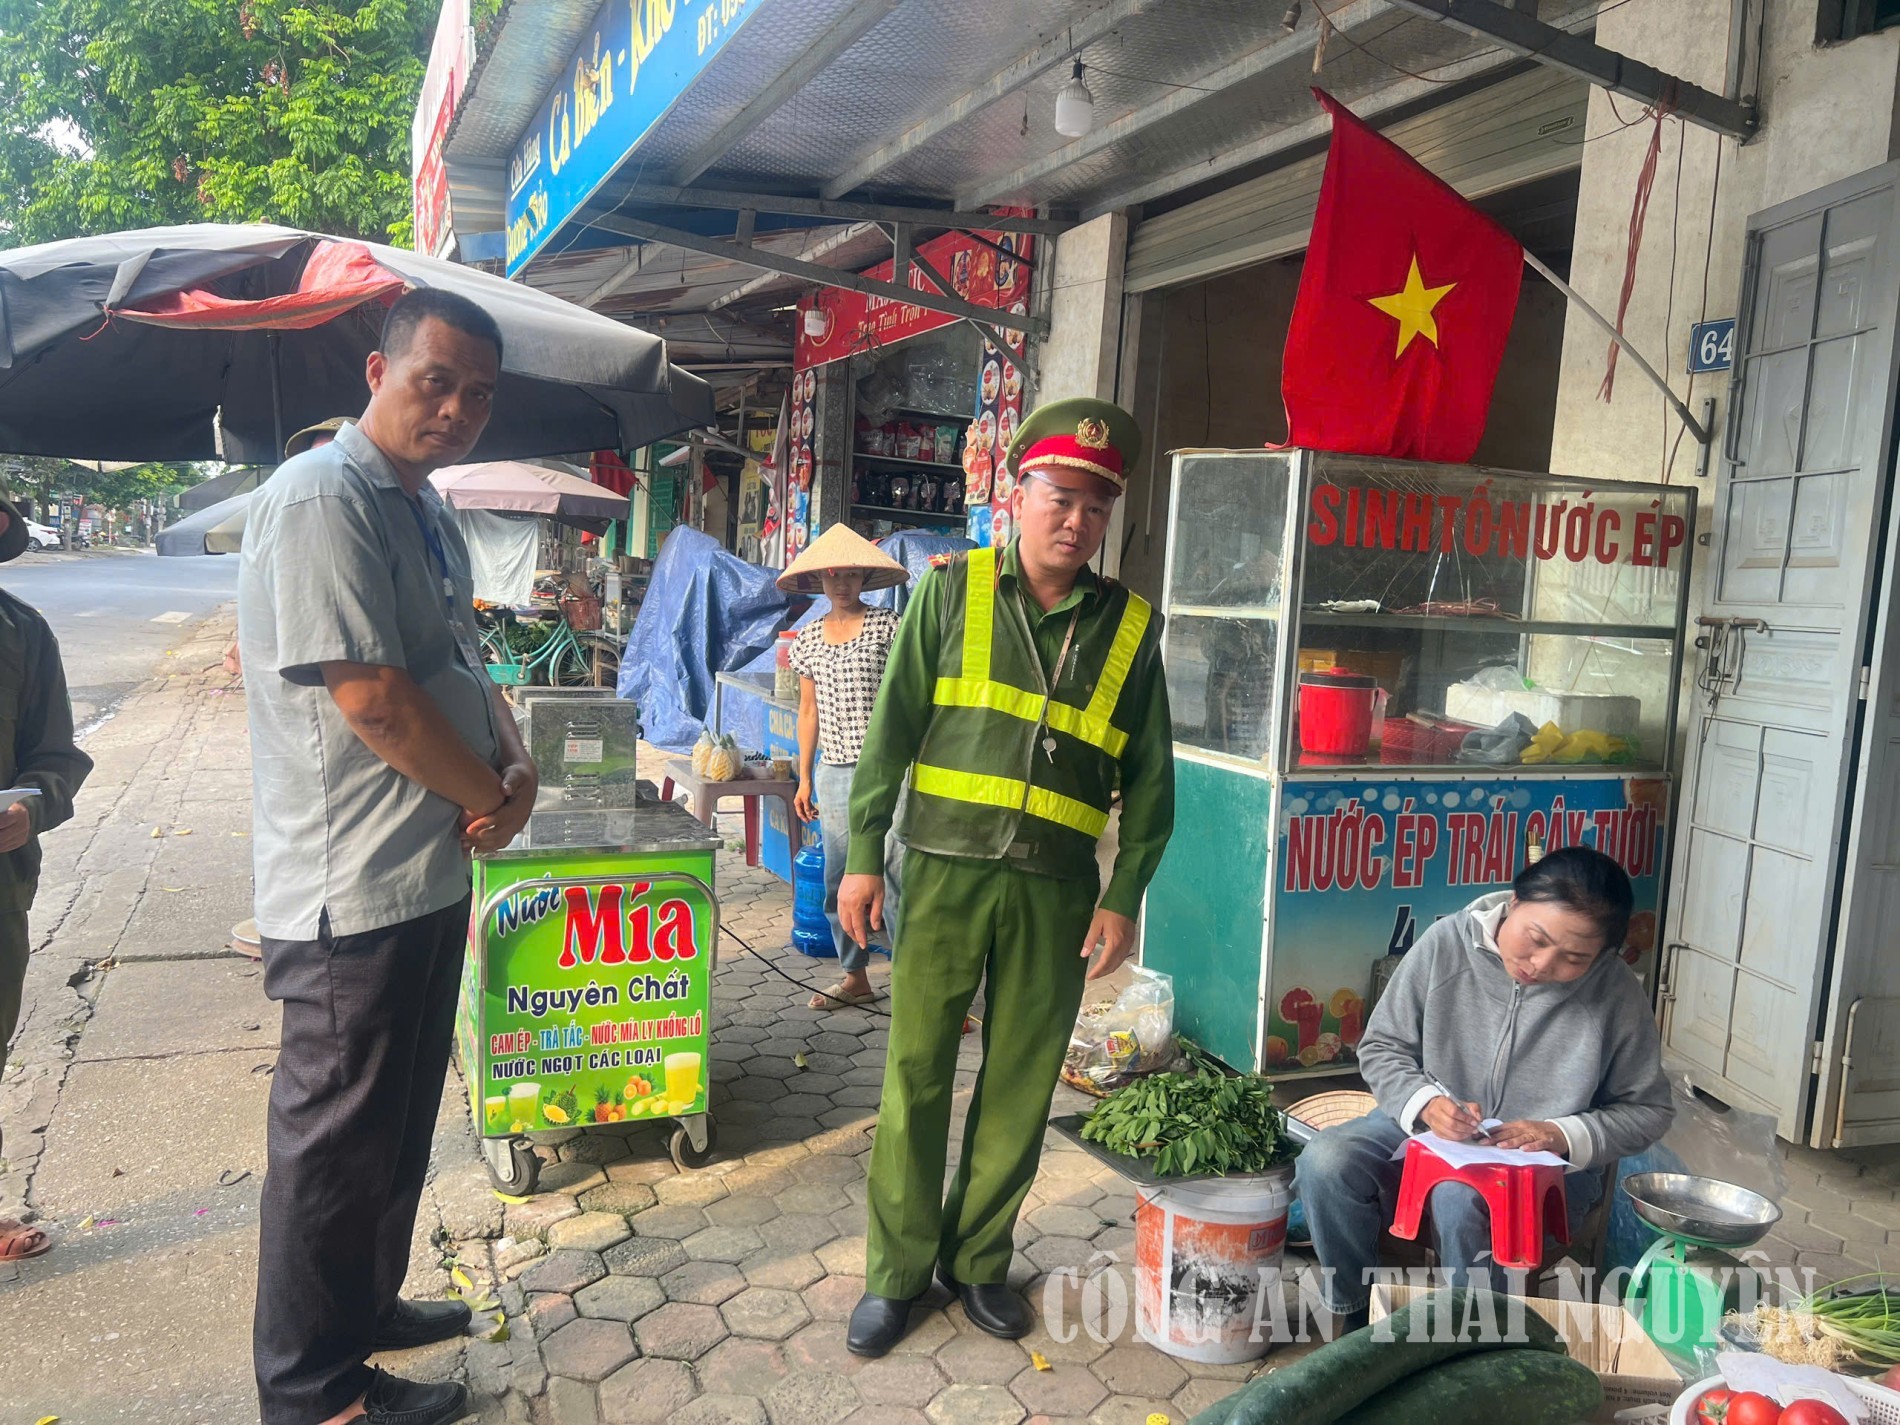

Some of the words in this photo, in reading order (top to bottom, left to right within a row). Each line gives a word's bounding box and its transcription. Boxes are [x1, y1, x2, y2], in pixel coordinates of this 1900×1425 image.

[1308, 484, 1431, 552] SINH
[1631, 499, 1684, 567] ÉP
[1284, 798, 1385, 892] NƯỚC
[1392, 797, 1438, 888] ÉP
[1447, 797, 1518, 884] TRÁI
[558, 881, 699, 969] Mía
[507, 981, 618, 1018] Nguyên
[628, 967, 690, 1003] Chất
[491, 1034, 515, 1055] CAM
[517, 1028, 532, 1053] ÉP
[540, 1025, 559, 1050] TRÀ
[620, 1016, 640, 1043] MÍA
[641, 1020, 654, 1041] LY
[492, 1056, 536, 1080] NƯỚC
[541, 1055, 583, 1076] NGỌT
[589, 1050, 621, 1070] CÁC
[626, 1047, 661, 1067] LOẠI
